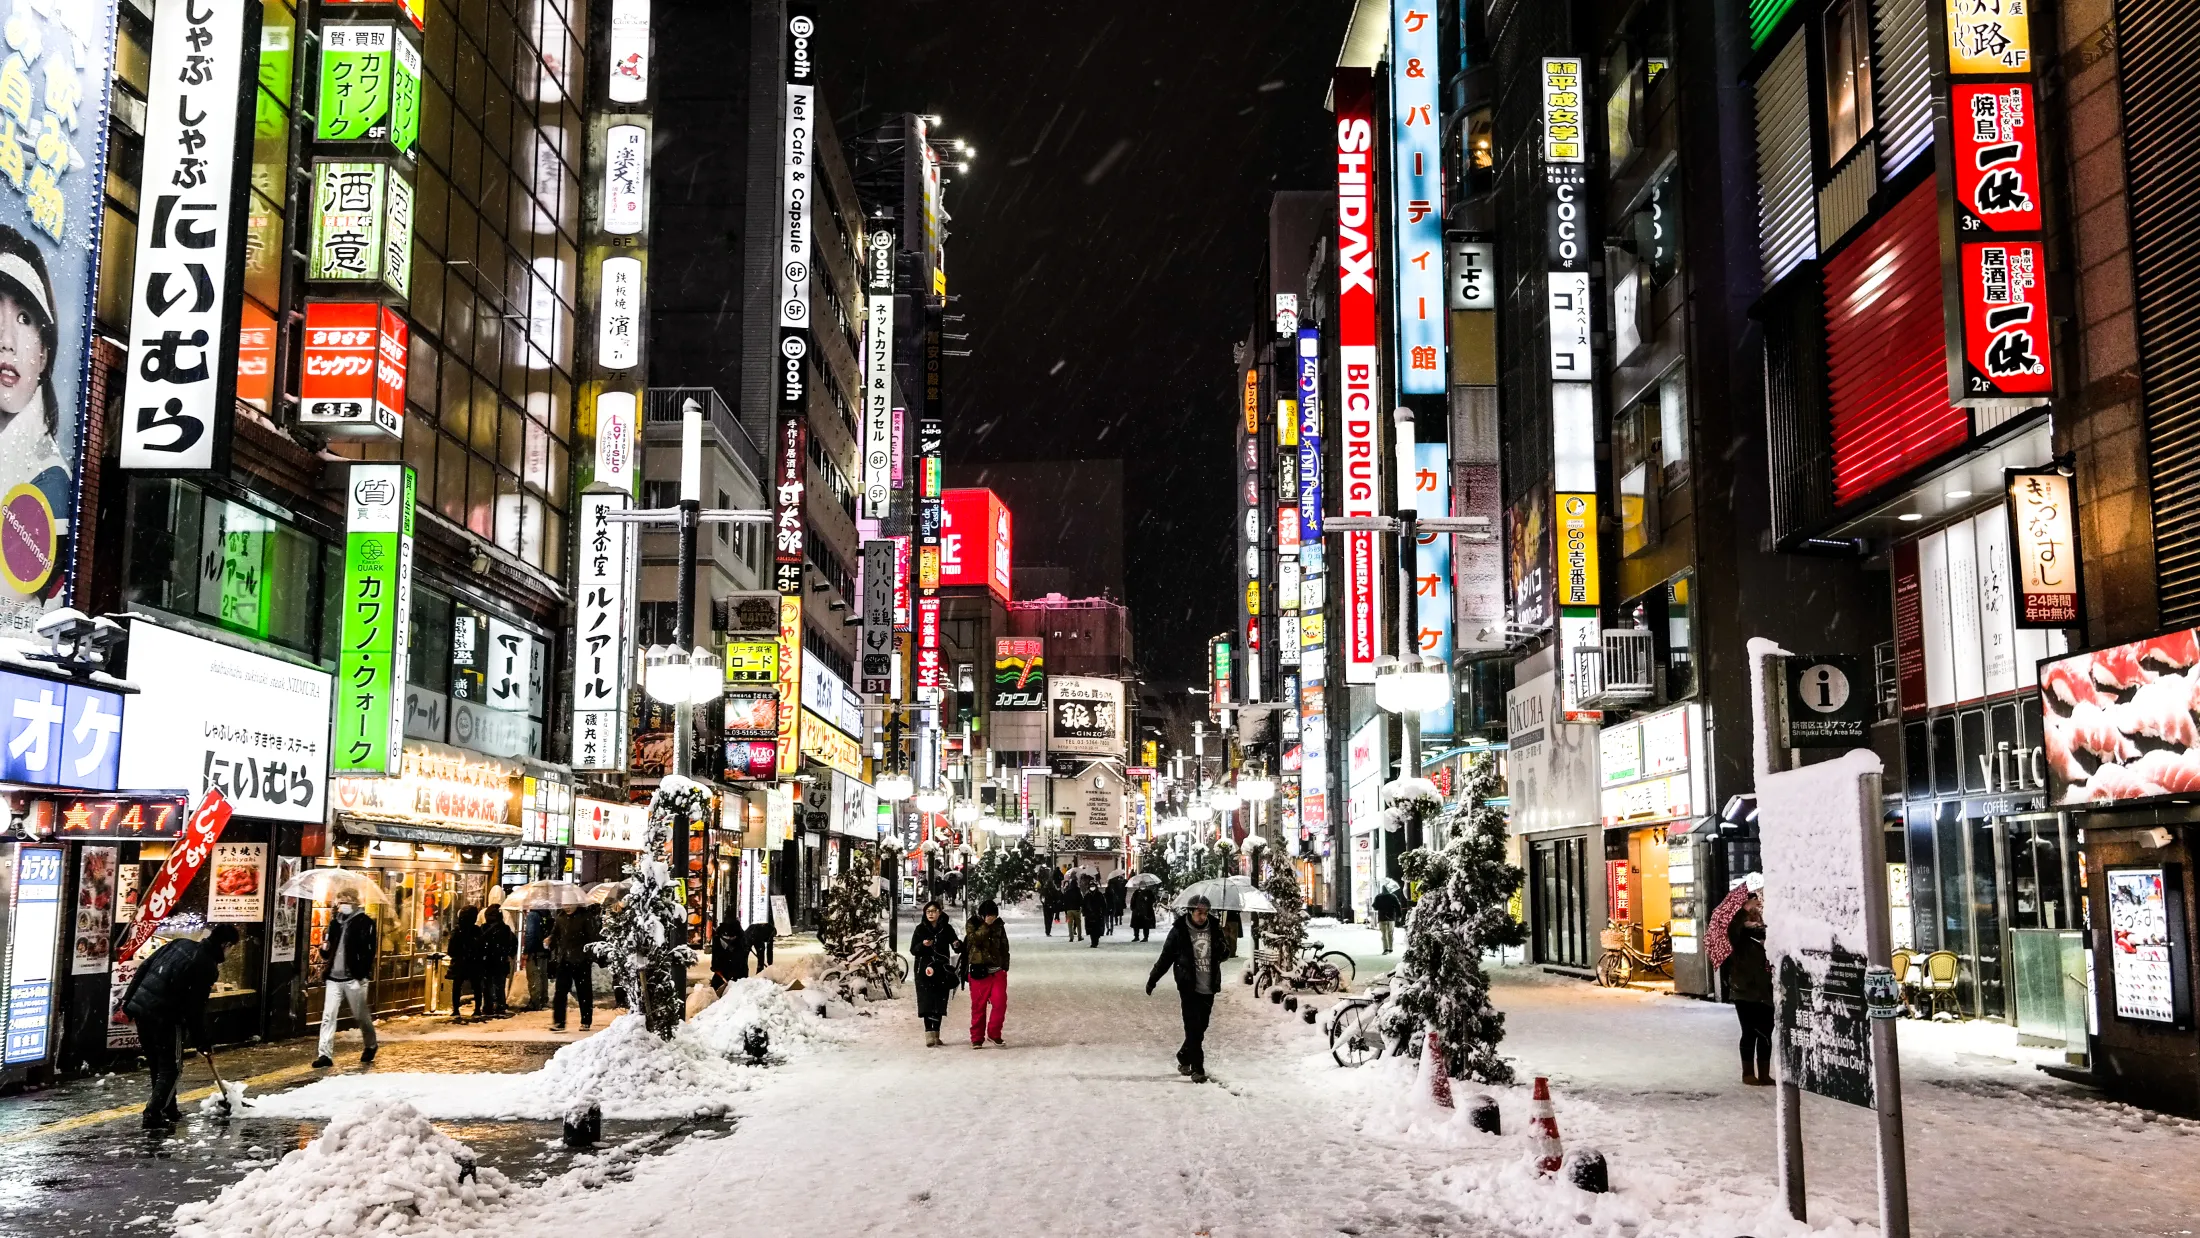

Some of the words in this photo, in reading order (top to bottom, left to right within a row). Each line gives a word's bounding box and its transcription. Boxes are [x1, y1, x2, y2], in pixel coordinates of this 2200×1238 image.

[790, 15, 815, 78] Booth
[2002, 50, 2026, 67] 4F
[1546, 62, 1578, 75] 新宿
[328, 61, 353, 137] クォーク
[793, 94, 806, 116] Net
[1548, 75, 1579, 158] 平成女学園
[1974, 94, 1998, 140] 焼鳥
[2011, 88, 2022, 126] 東京で一番
[368, 126, 386, 138] 5F
[2000, 96, 2012, 141] 旨くて安い店
[612, 147, 636, 194] 楽天屋
[792, 171, 806, 182] &
[1546, 166, 1577, 175] Hair
[1547, 176, 1585, 184] Space
[1978, 145, 2025, 211] 一休
[788, 189, 805, 254] Capsule
[1337, 118, 1373, 295] SHIDAX
[1557, 184, 1578, 260] COCO
[1961, 215, 1981, 231] 3F
[872, 230, 893, 288] Booth
[1562, 259, 1573, 268] 4F
[1983, 249, 2007, 302] 居酒屋
[2022, 248, 2033, 287] 東京で一番
[2011, 256, 2023, 302] 旨くて安い店
[136, 194, 218, 453] にいむら
[1575, 277, 1587, 346] ヘアースペース
[874, 303, 888, 371] ネットカフェ
[1553, 292, 1574, 371] ココ
[1988, 307, 2035, 376] 一休
[307, 356, 373, 376] ビックワン
[781, 335, 806, 401] Booth
[874, 378, 885, 389] &
[1971, 376, 1991, 392] 2F
[1347, 364, 1370, 412] BIC
[322, 402, 352, 417] 3F
[380, 409, 394, 427] 3F
[872, 394, 887, 442] カプセル
[786, 418, 798, 479] 手作り居酒屋
[1348, 420, 1372, 501] DRUG
[776, 480, 804, 554] 甘太郎
[2026, 477, 2064, 586] きづなすし
[1, 504, 52, 573] entertainment
[592, 503, 612, 577] 喫茶室
[203, 550, 257, 595] ルノアール
[357, 564, 384, 572] QUARK
[777, 578, 799, 592] 3F
[778, 564, 800, 578] 4F
[222, 594, 238, 619] 2F
[2026, 607, 2076, 621] 年中無休
[2028, 594, 2073, 608] 24時間
[584, 586, 614, 700] ルノアール
[732, 655, 773, 669] ロード
[733, 645, 773, 654] リーチ麻雀
[286, 677, 320, 698] NIIMURA
[347, 575, 383, 766] カワノ・クォーク
[867, 679, 886, 692] B1
[775, 625, 796, 769] やきとりセンター
[995, 692, 1042, 706] カワノ
[8, 689, 122, 779] オケ
[204, 720, 316, 757] しゃぶしゃぶ・すきやき・ステーキ
[584, 713, 598, 765] 磯丸水産
[1791, 720, 1863, 730] 新宿区エリアマップ
[1791, 729, 1819, 737] Shinjuku
[1819, 729, 1833, 737] City
[1849, 729, 1863, 737] Map
[750, 748, 775, 758] MAO
[202, 750, 314, 808] にいむら
[95, 804, 173, 831] 747
[1982, 798, 2009, 815] COFFEE
[908, 812, 919, 849] カラオケ
[20, 856, 60, 881] カラオケ
[218, 846, 261, 857] すき焼き
